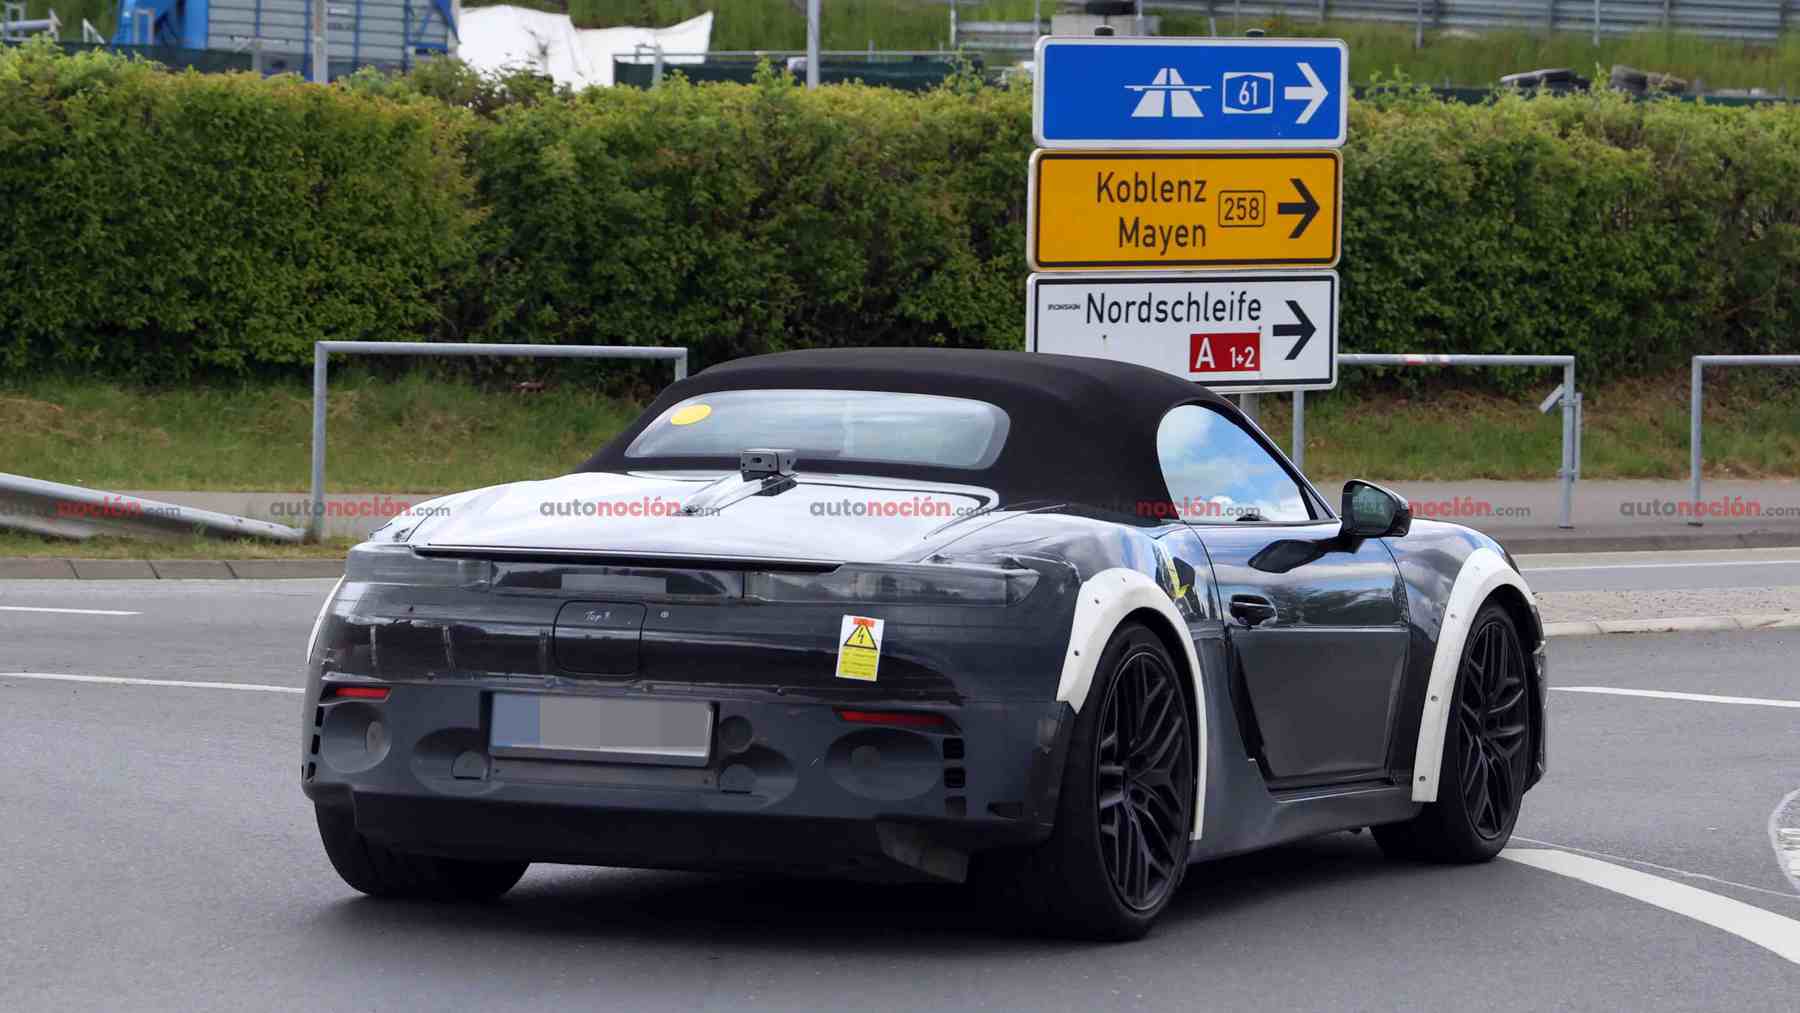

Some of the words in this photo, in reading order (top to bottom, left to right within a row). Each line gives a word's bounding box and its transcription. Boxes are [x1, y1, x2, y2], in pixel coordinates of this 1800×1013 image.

[1239, 80, 1258, 105] 61
[1096, 172, 1207, 204] Koblenz
[1223, 197, 1260, 221] 258
[1118, 217, 1207, 256] Mayen
[1086, 291, 1262, 324] Nordschleife
[1194, 337, 1216, 369] A
[1229, 346, 1255, 369] 1+2
